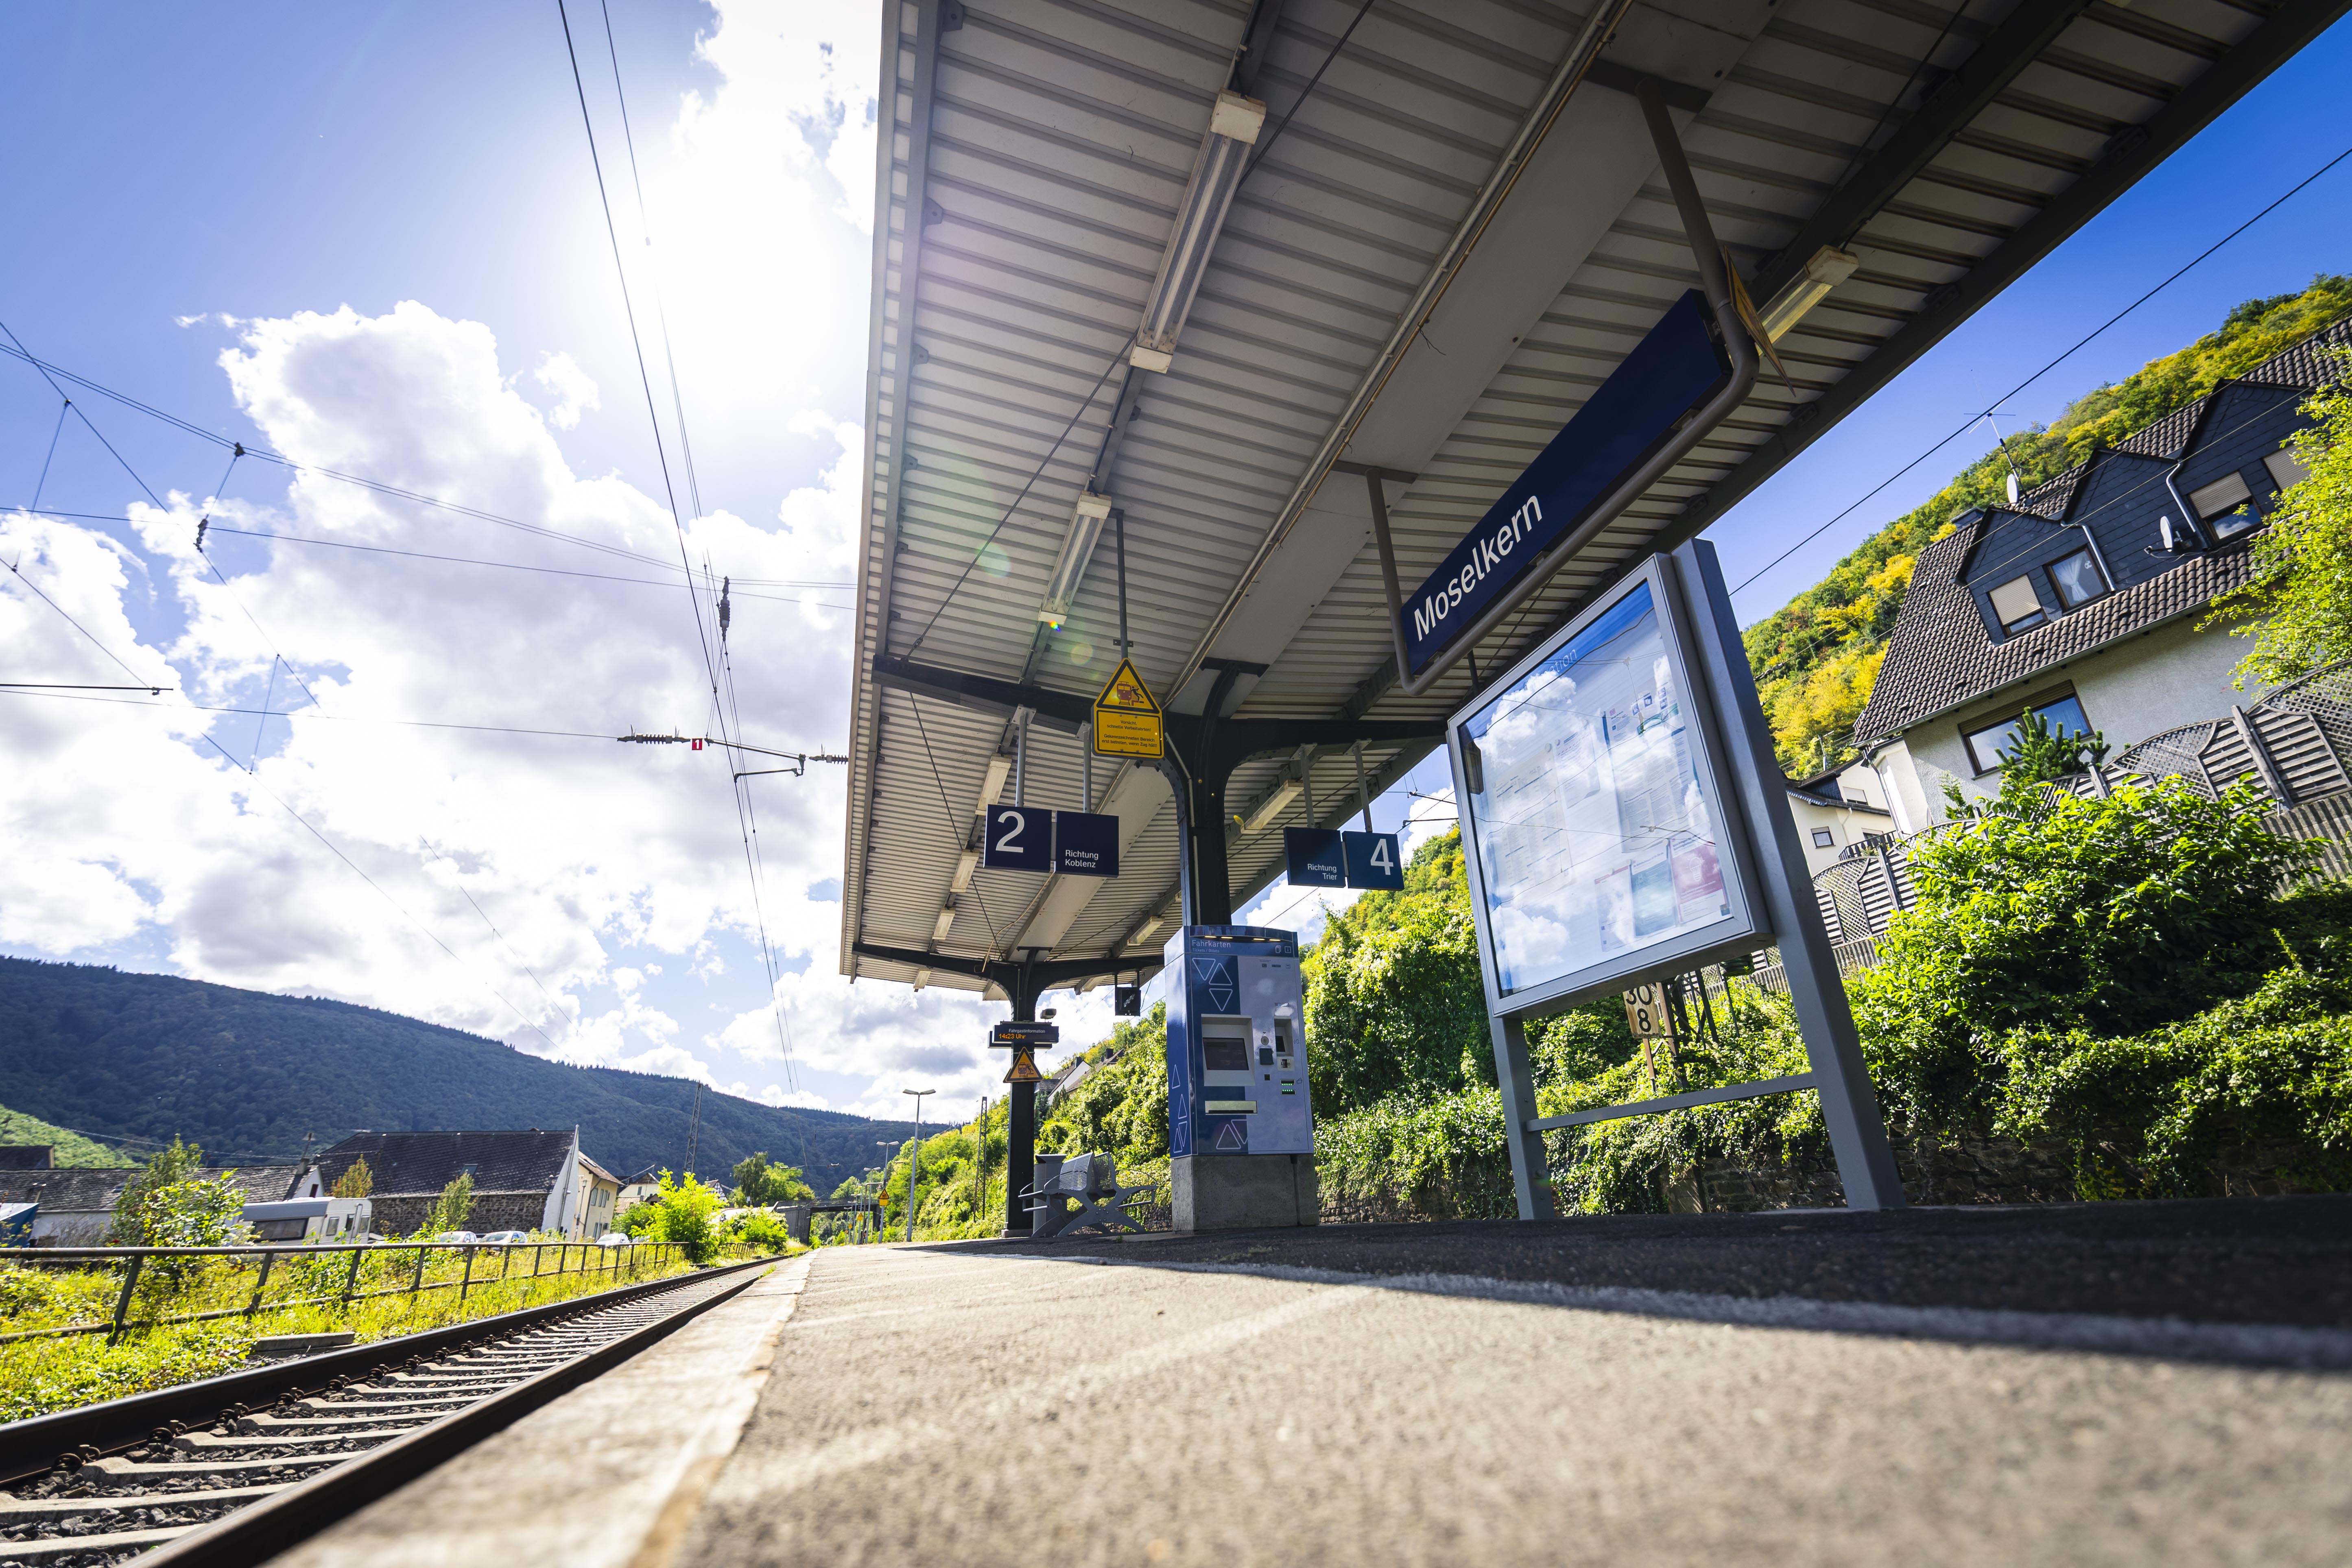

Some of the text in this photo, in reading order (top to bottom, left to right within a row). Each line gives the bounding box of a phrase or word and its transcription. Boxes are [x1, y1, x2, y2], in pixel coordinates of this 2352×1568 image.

[1414, 496, 1542, 642] Moselkern
[695, 740, 699, 749] 1
[996, 811, 1025, 853] 2
[1065, 850, 1098, 860] Richtung
[1370, 839, 1394, 875] 4
[1065, 858, 1096, 868] Koblenz
[1307, 863, 1337, 873] Richtung
[1192, 939, 1231, 948] Fahrkarten
[1637, 1008, 1651, 1032] 8
